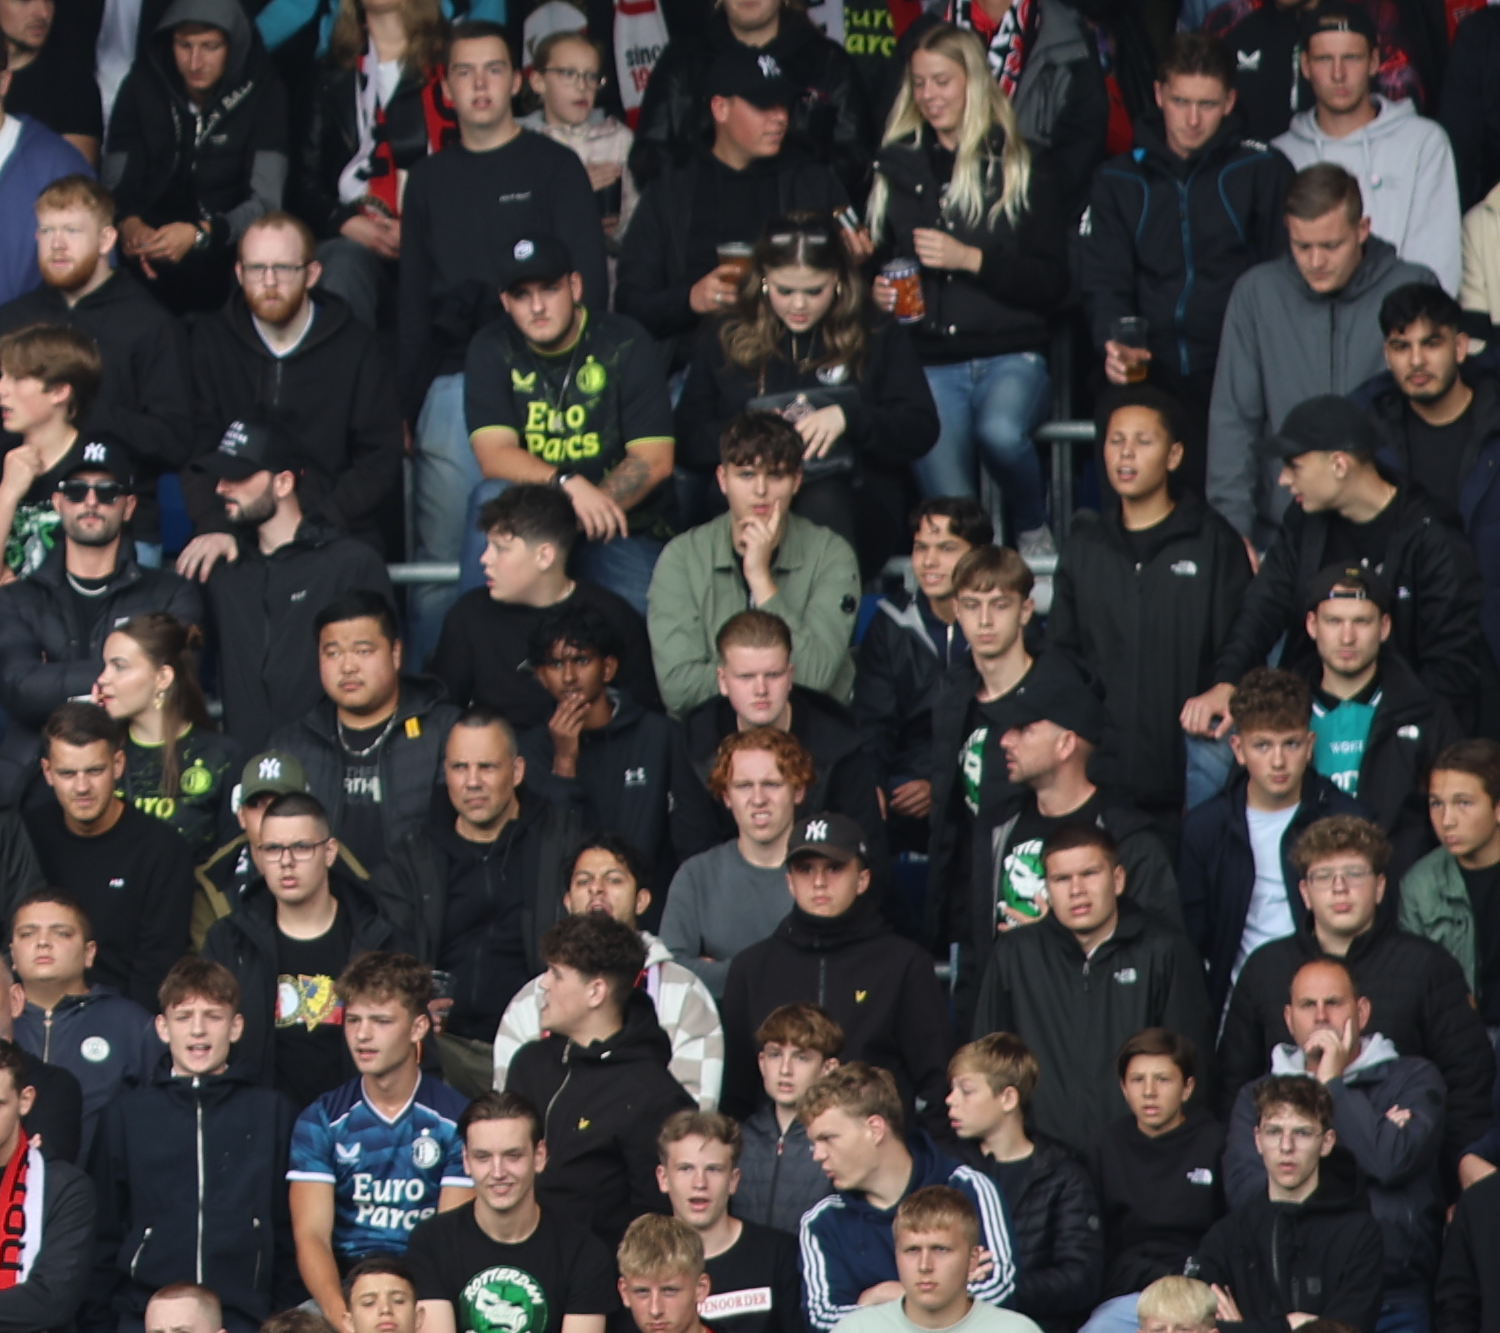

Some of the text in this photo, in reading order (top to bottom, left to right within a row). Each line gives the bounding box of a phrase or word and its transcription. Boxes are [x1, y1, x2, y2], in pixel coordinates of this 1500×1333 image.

[625, 44, 665, 68] sinc
[804, 819, 829, 842] NY
[351, 1172, 426, 1204] Euro
